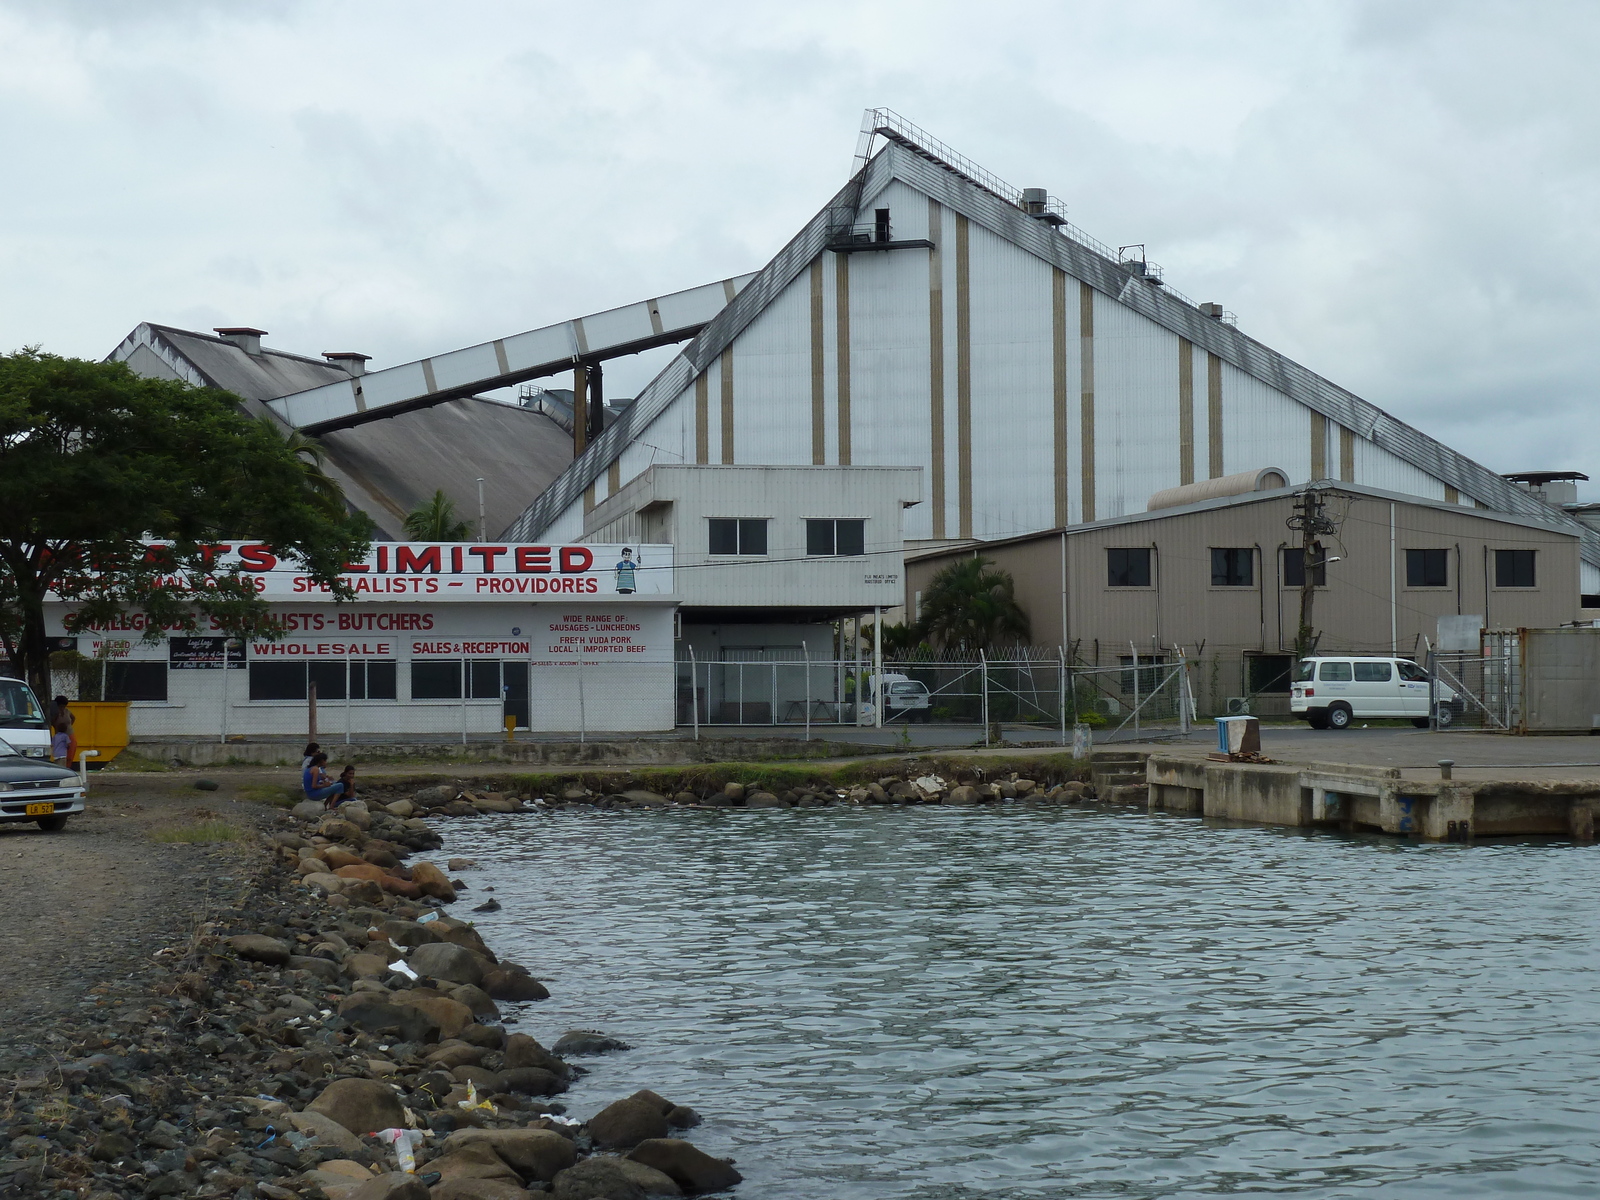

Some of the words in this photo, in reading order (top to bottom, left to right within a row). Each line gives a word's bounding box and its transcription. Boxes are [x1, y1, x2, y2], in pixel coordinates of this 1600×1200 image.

[293, 576, 438, 593] SPEIALISTS
[476, 577, 598, 593] PROVIDORES
[560, 636, 585, 644] FRESH
[588, 636, 609, 644] VUDA
[611, 636, 632, 644] PORK
[253, 643, 390, 655] WHOLESALE
[412, 642, 452, 654] SALES
[462, 642, 529, 654] RECEPTION
[548, 645, 574, 653] LOCAL
[583, 645, 624, 653] IMPORTED
[626, 645, 647, 653] BEEF
